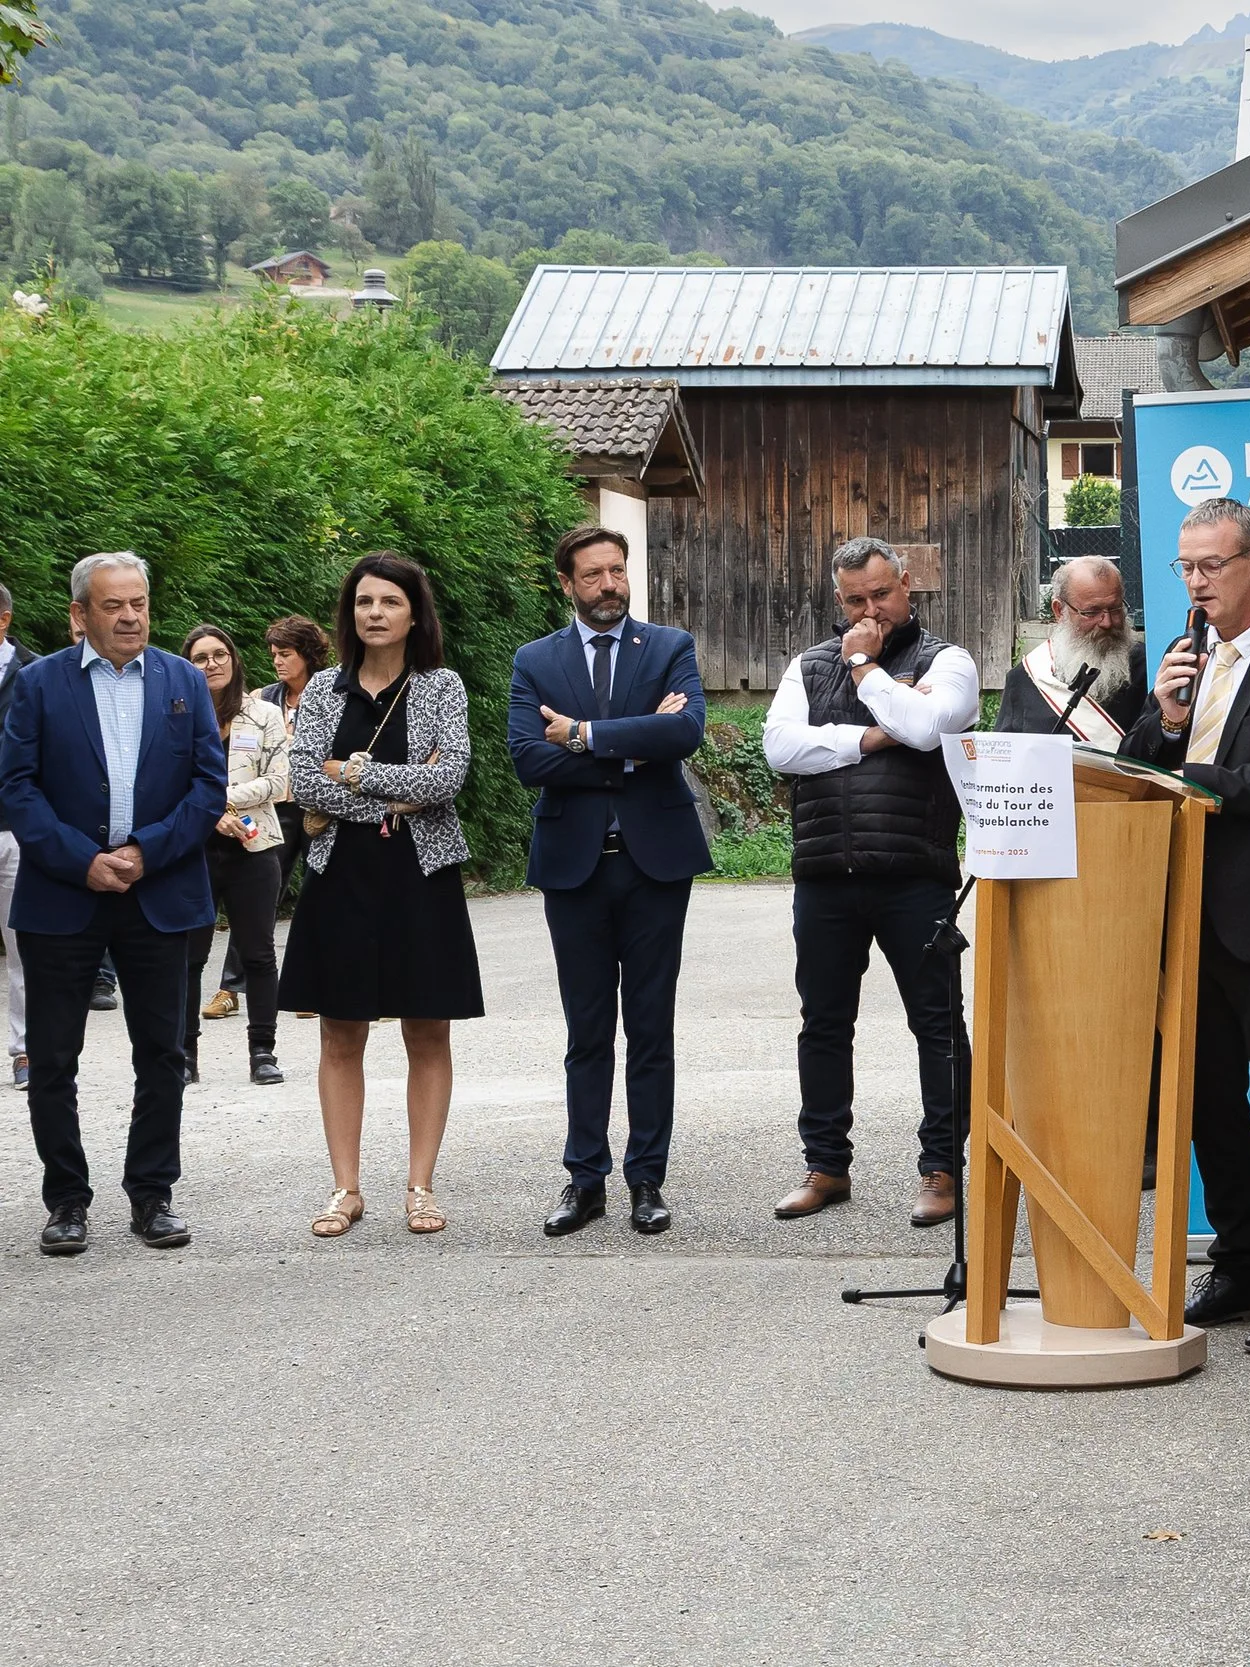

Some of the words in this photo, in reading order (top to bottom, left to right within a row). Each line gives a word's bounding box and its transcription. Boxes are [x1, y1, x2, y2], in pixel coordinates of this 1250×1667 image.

[976, 783, 1025, 794] ormation
[1030, 783, 1053, 794] des
[986, 798, 999, 810] du
[1004, 800, 1032, 811] Tour
[1037, 799, 1054, 810] de
[978, 815, 1049, 828] gueblanche
[1007, 848, 1029, 856] 2025
